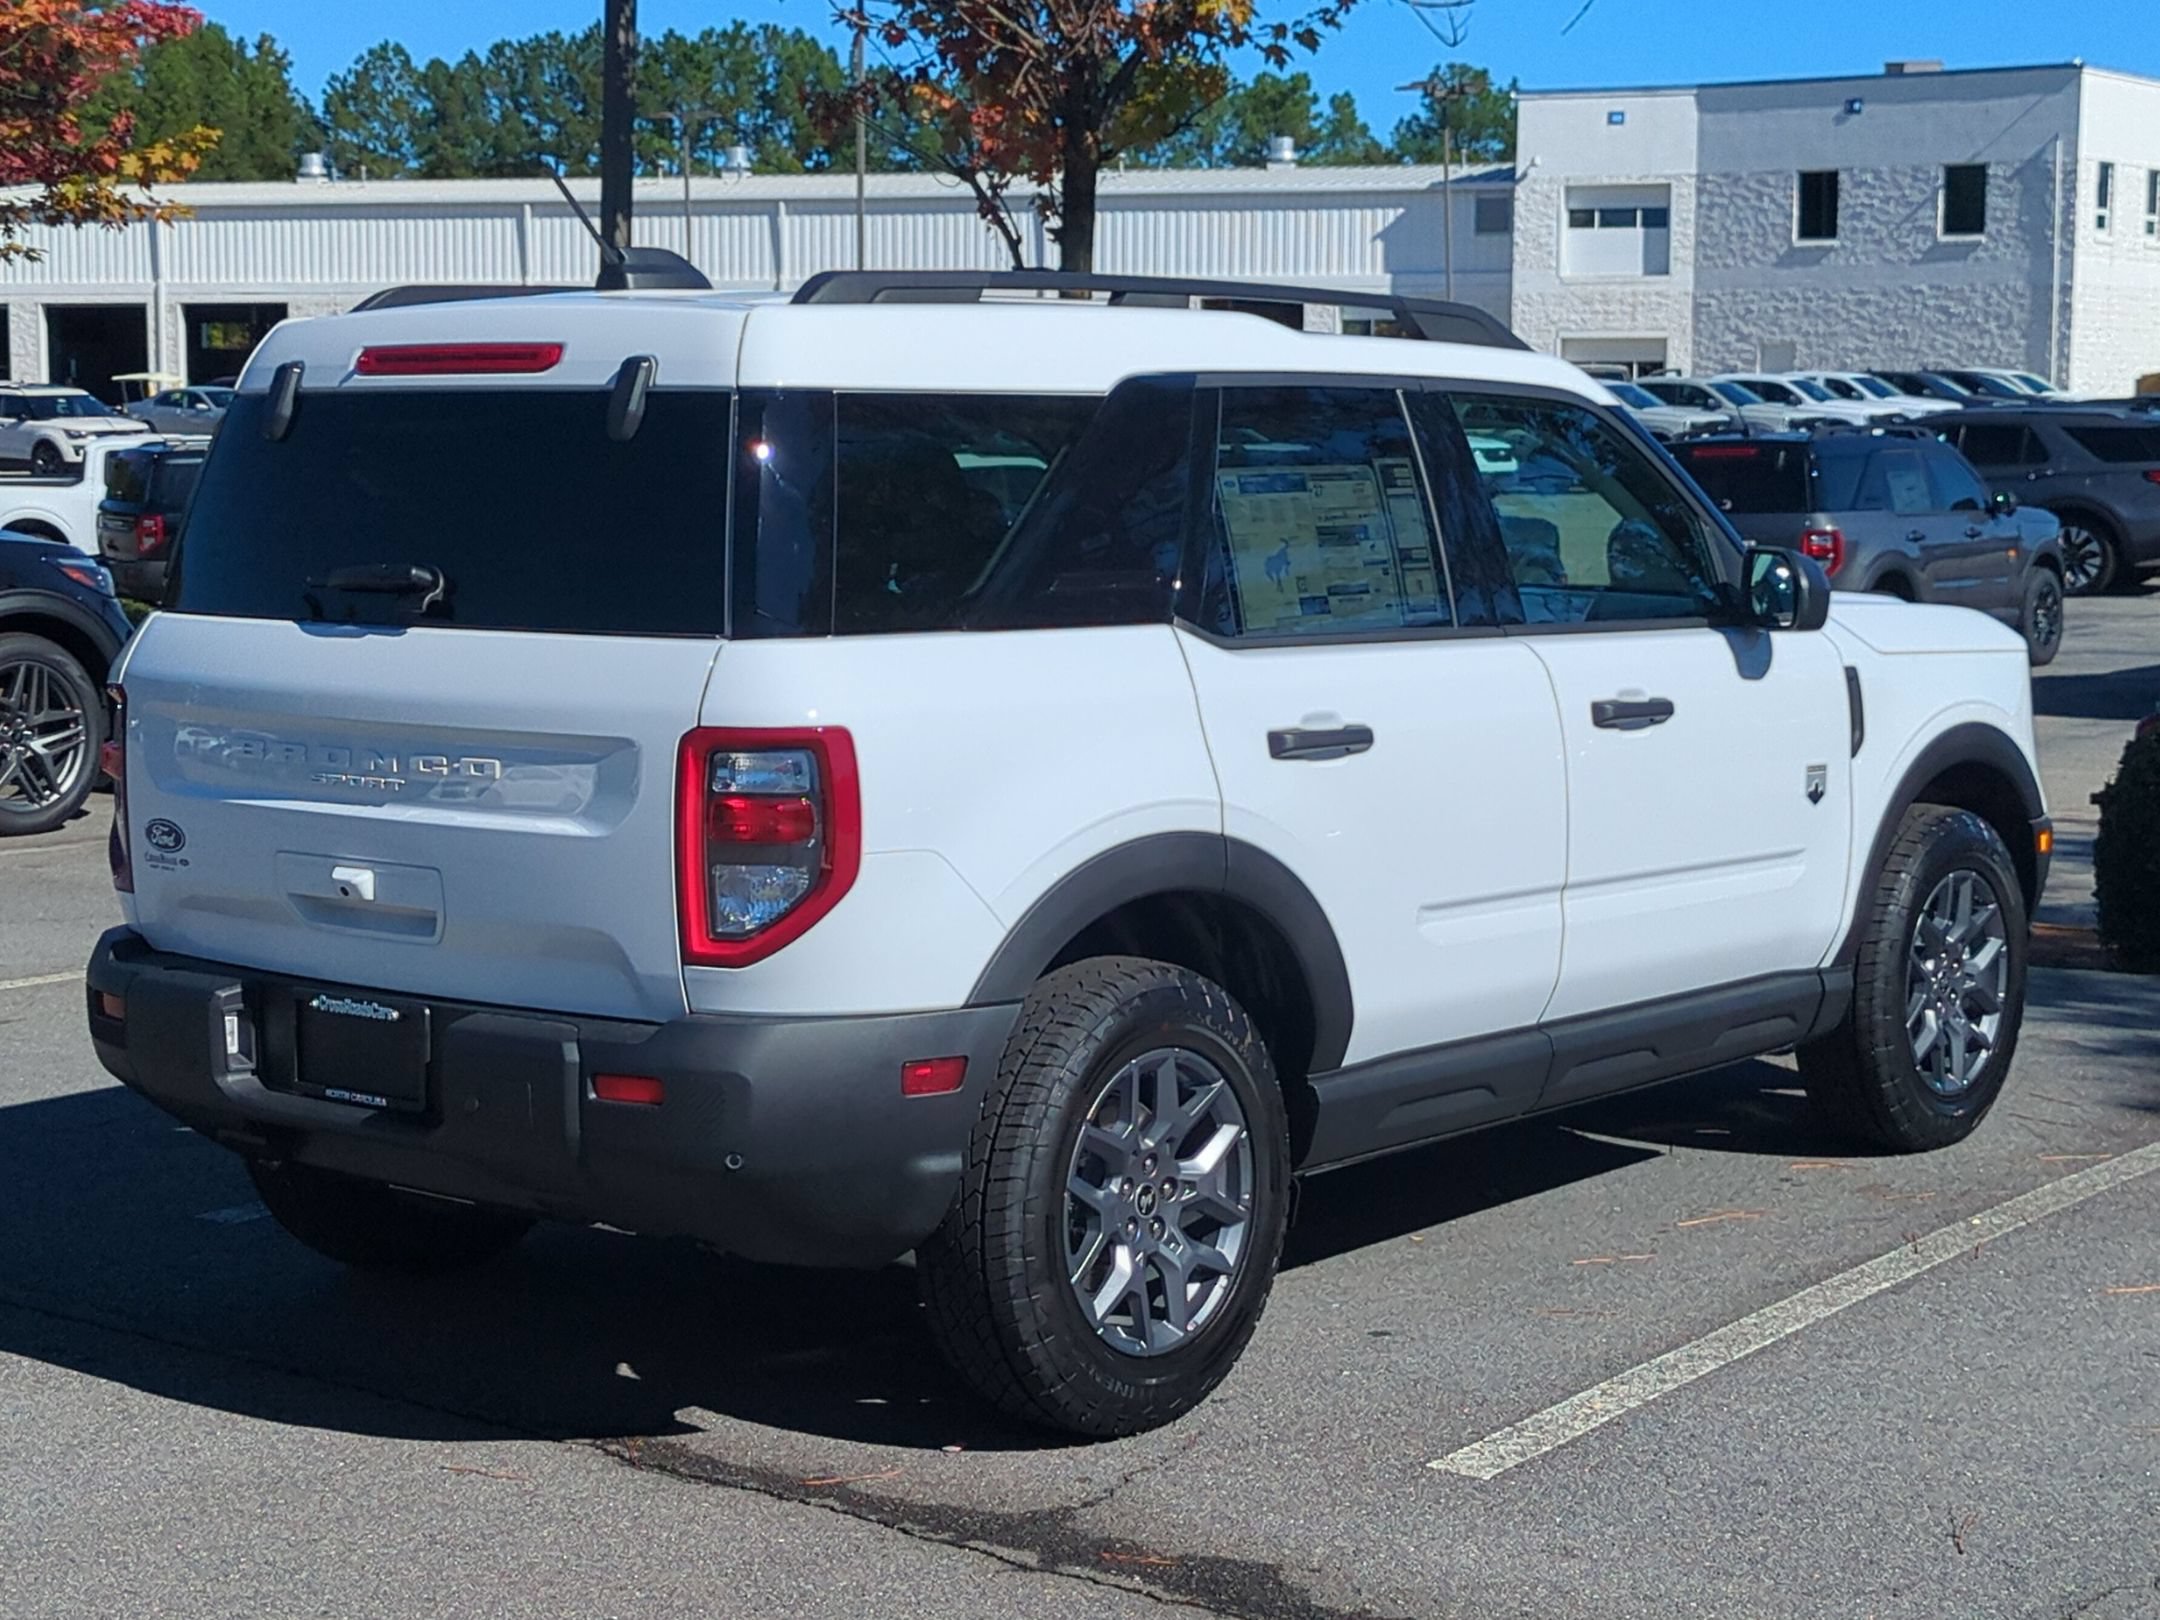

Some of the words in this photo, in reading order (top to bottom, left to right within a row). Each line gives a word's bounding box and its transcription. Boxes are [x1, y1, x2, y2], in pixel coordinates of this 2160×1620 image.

[234, 738, 500, 779] BRONCO
[310, 773, 405, 790] SPORT
[149, 823, 179, 848] Ford
